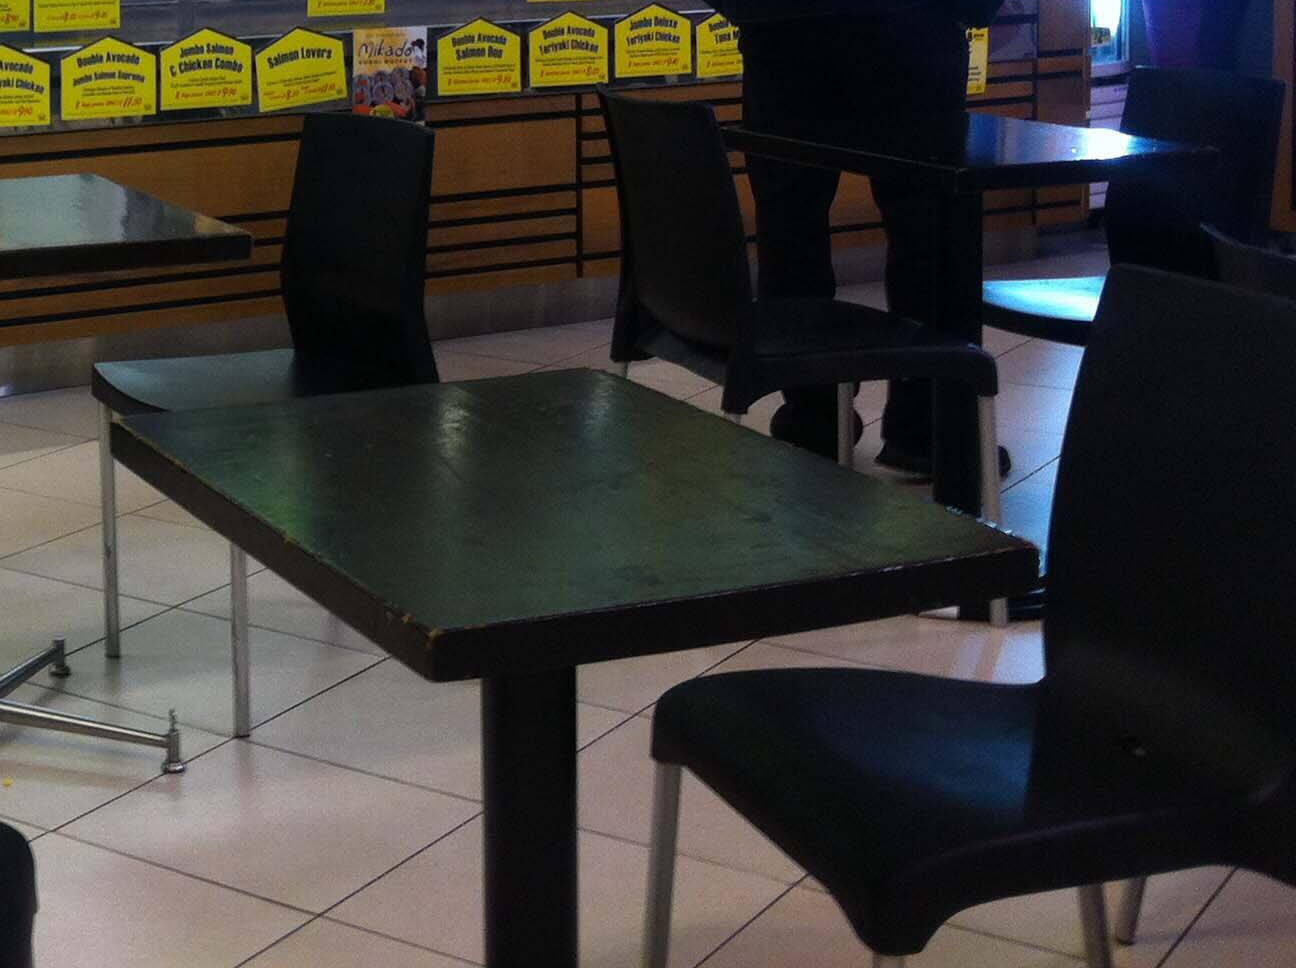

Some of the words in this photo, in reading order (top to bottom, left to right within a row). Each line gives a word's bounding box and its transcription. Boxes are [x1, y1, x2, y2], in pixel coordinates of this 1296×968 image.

[267, 50, 300, 69] Salmon
[301, 47, 332, 61] Lovers
[358, 38, 413, 58] Mikado
[179, 58, 213, 73] Chicken
[215, 57, 243, 73] Combo
